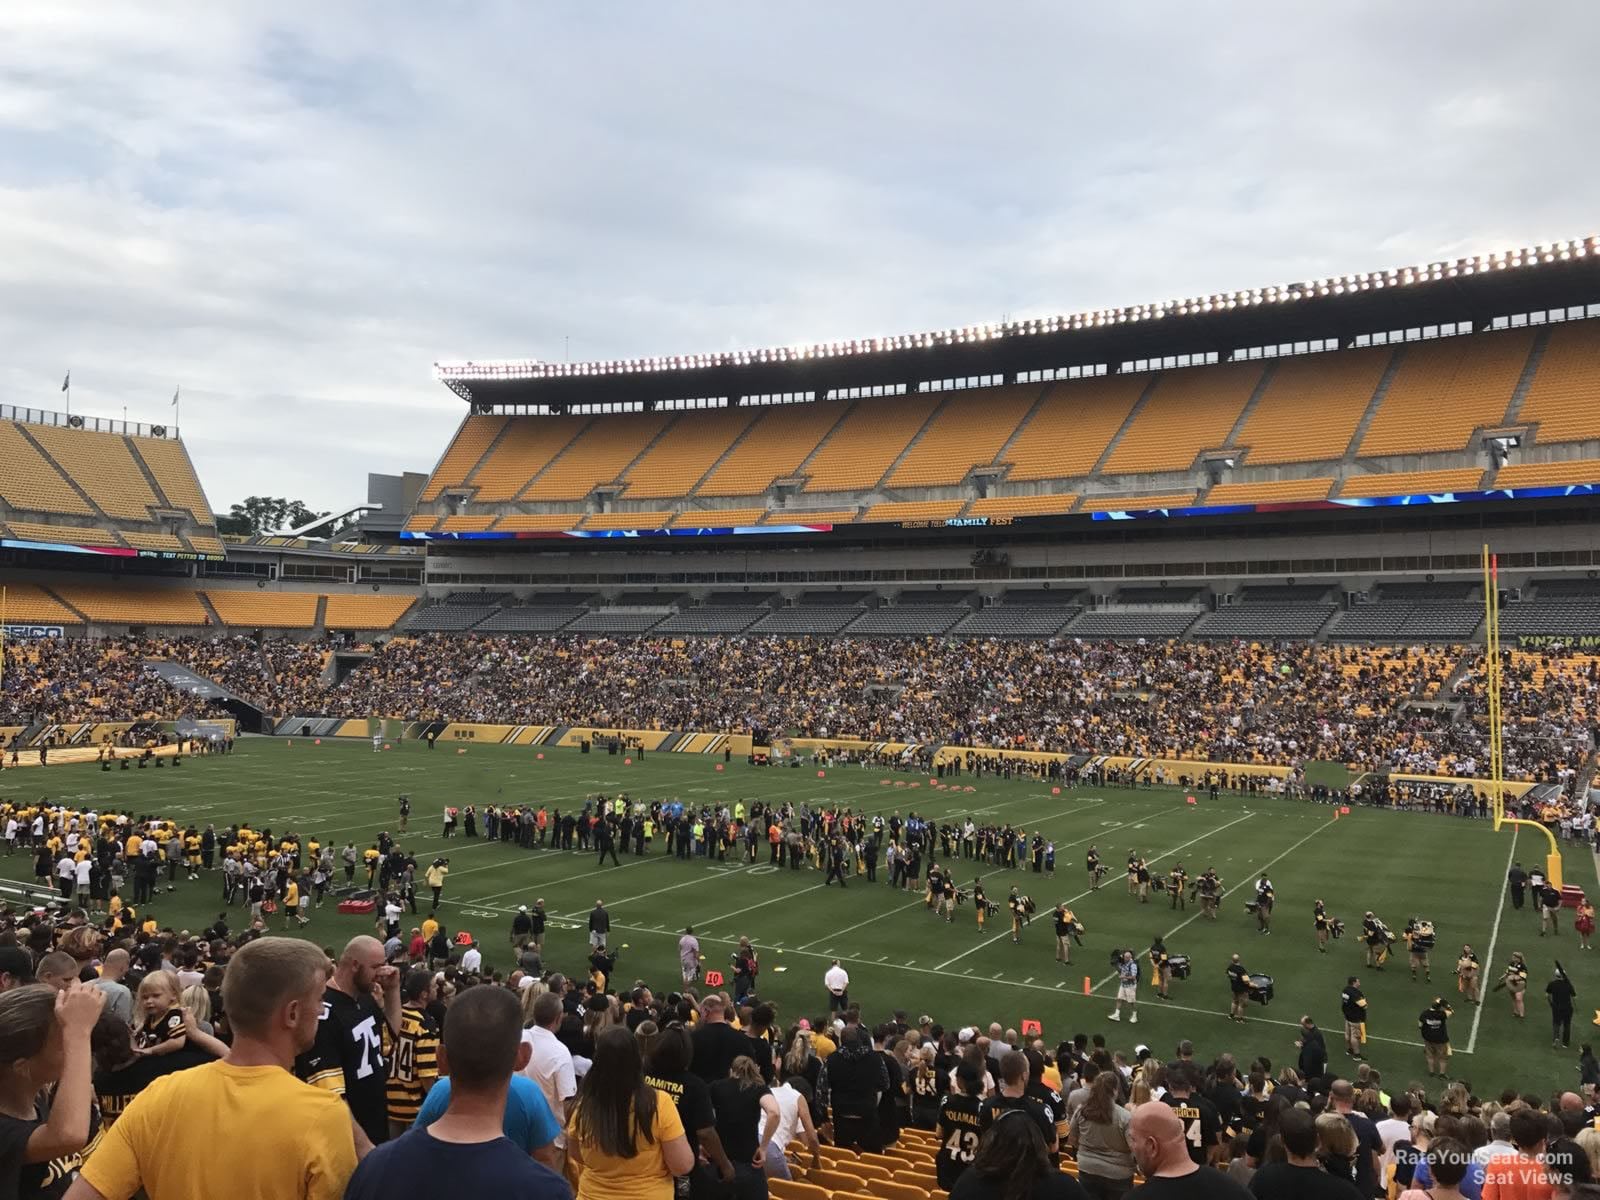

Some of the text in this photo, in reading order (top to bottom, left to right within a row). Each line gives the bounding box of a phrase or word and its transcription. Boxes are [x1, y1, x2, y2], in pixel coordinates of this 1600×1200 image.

[990, 517, 1013, 526] FEST
[707, 972, 719, 985] 10
[644, 1075, 684, 1094] DAMITRA
[945, 1109, 981, 1127] POLAMAL
[945, 1129, 979, 1162] 43
